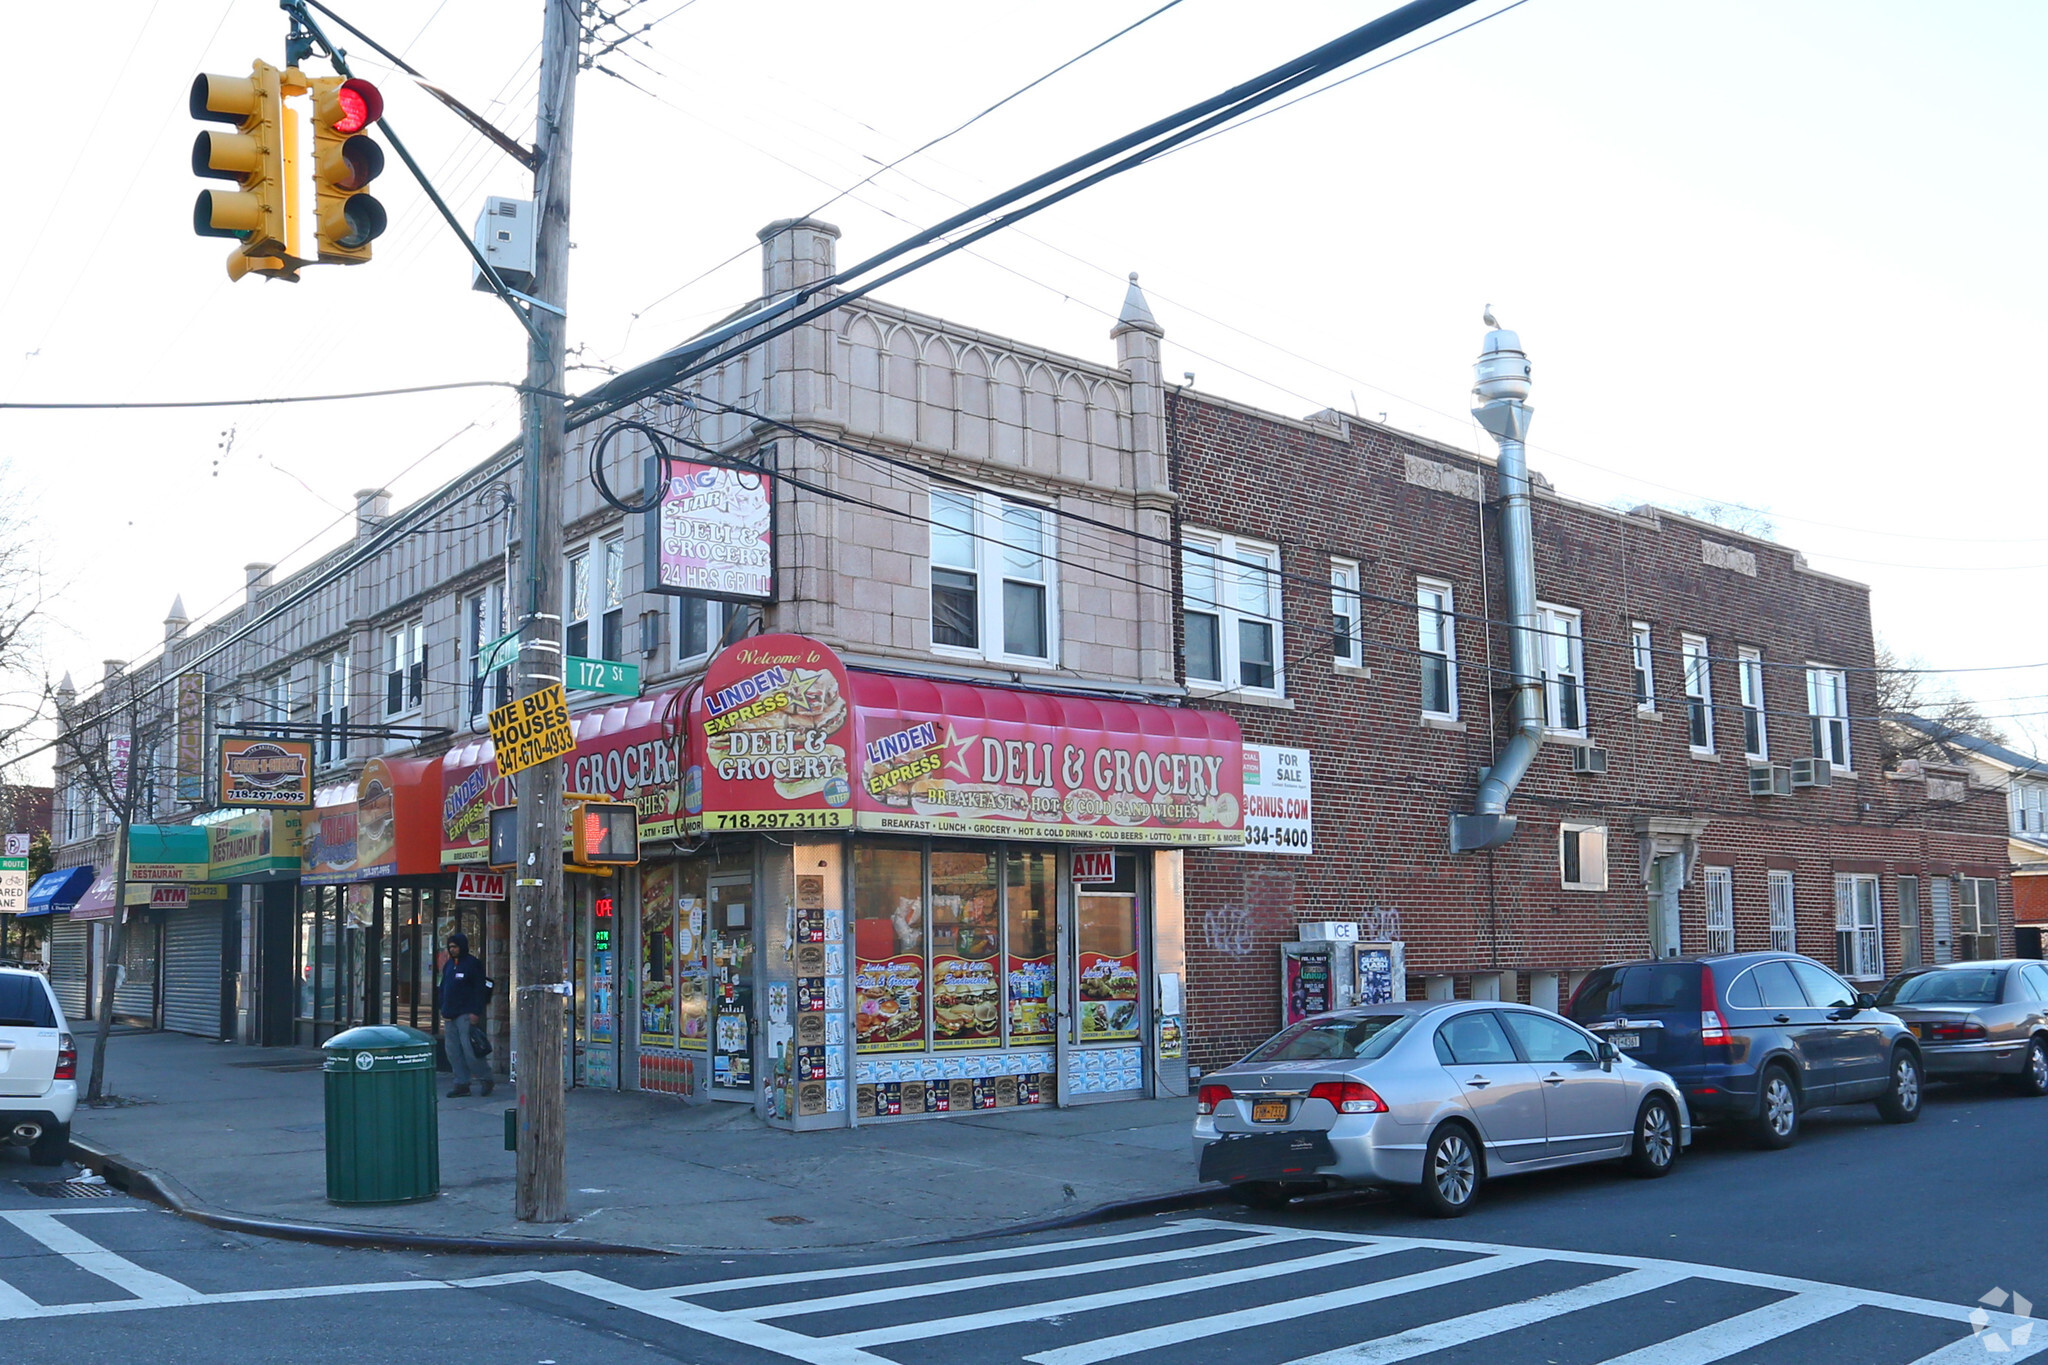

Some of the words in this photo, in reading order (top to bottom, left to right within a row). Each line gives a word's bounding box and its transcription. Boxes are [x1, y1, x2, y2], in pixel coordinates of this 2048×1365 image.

[670, 470, 717, 497] BIG
[666, 491, 722, 517] STAR
[673, 518, 732, 544] DELI
[739, 528, 760, 548] &
[664, 537, 769, 567] GROCERY
[661, 562, 681, 585] 24
[686, 565, 720, 590] HRS
[724, 570, 771, 594] GRILL
[737, 649, 802, 665] Welcome
[806, 650, 821, 663] to
[580, 662, 605, 688] 172
[612, 666, 623, 681] St
[704, 666, 787, 716] LINDEN
[489, 704, 519, 730] WE
[522, 686, 560, 717] BUY
[703, 692, 790, 737] EXPRESS
[493, 705, 568, 750] HOUSES
[497, 726, 574, 775] 347-670-4933
[728, 730, 796, 756] DELI
[803, 729, 828, 754] &
[866, 721, 937, 765] LINDEN
[575, 736, 684, 795] GROCERY
[717, 755, 838, 780] GROCERY
[981, 737, 1054, 787] DELI
[1062, 744, 1085, 790] &
[1093, 748, 1223, 797] GROCERY
[1278, 753, 1298, 767] FOR
[869, 753, 942, 795] EXPRESS
[1276, 769, 1302, 782] SALE
[227, 790, 304, 801] 718.297.0995
[445, 765, 485, 820] LINDEN
[927, 788, 1015, 810] BREAKFAST
[1031, 796, 1060, 812] HOT
[1063, 798, 1073, 812] &
[1076, 800, 1112, 815] COLD
[1115, 800, 1199, 819] SANDWICHES
[449, 798, 485, 842] EXPRESS
[1243, 794, 1309, 820] @CRNUS.COM
[643, 827, 657, 838] ATM
[661, 825, 674, 835] EBT
[687, 821, 702, 831] MOR
[717, 812, 840, 829] 718.297.3113
[881, 818, 930, 830] BREAKFAST
[938, 822, 966, 832] LUNCH
[974, 824, 1011, 834] GROCERY
[1018, 827, 1034, 836] HOT
[1036, 828, 1042, 836] &
[1044, 828, 1063, 837] COLD
[1065, 829, 1093, 838] DRINKS
[1100, 831, 1119, 839] COLD
[1121, 832, 1143, 840] BEERS
[1149, 833, 1172, 841] LOTTO
[1178, 833, 1192, 841] ATM
[1198, 833, 1211, 841] EBT
[1223, 834, 1242, 842] MORE
[213, 834, 257, 863] RESTAURANT
[1245, 825, 1308, 848] 334-5400
[453, 851, 478, 861] BREAKFAST
[1072, 853, 1113, 876] ATM
[132, 870, 183, 879] RESTAURANT
[458, 873, 504, 895] ATM
[153, 889, 186, 902] ATM
[595, 899, 613, 917] OPE
[1334, 924, 1350, 938] ICE
[864, 963, 885, 972] Linden
[887, 962, 911, 973] Express
